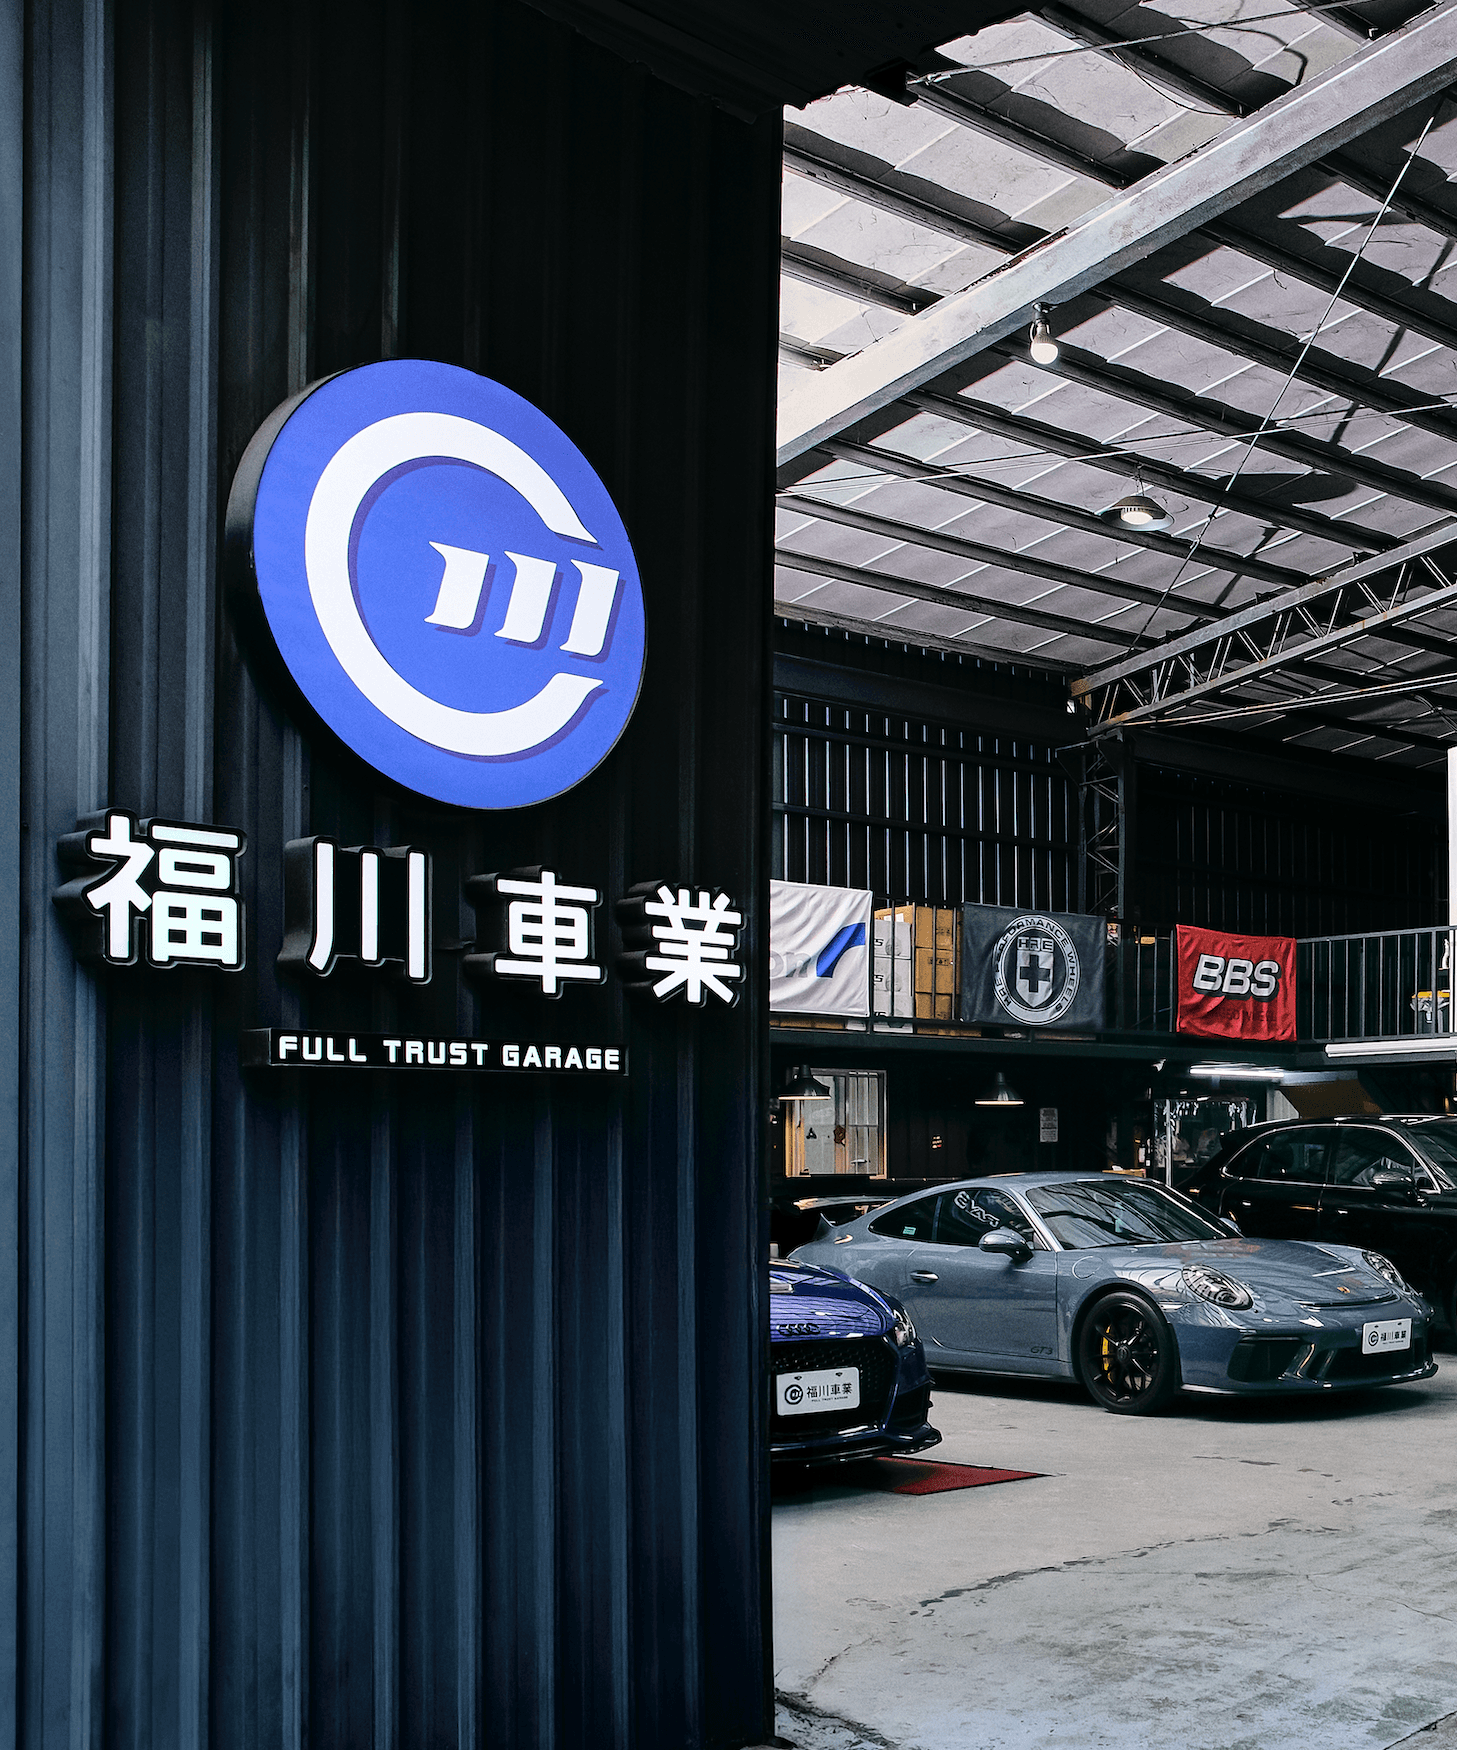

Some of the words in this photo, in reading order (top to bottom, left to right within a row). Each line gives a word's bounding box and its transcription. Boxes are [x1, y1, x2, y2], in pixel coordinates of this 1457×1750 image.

[87, 815, 743, 1004] 福川車業
[1017, 936, 1054, 951] HRE
[995, 918, 1069, 972] RFORMANCE
[1055, 951, 1076, 1012] WHEELS
[1193, 953, 1280, 999] BBS
[279, 1035, 367, 1062] FULL
[383, 1039, 489, 1067] TRUST
[502, 1043, 621, 1071] GARAGE
[1030, 1346, 1054, 1356] GT3
[806, 1382, 853, 1398] 福川車業
